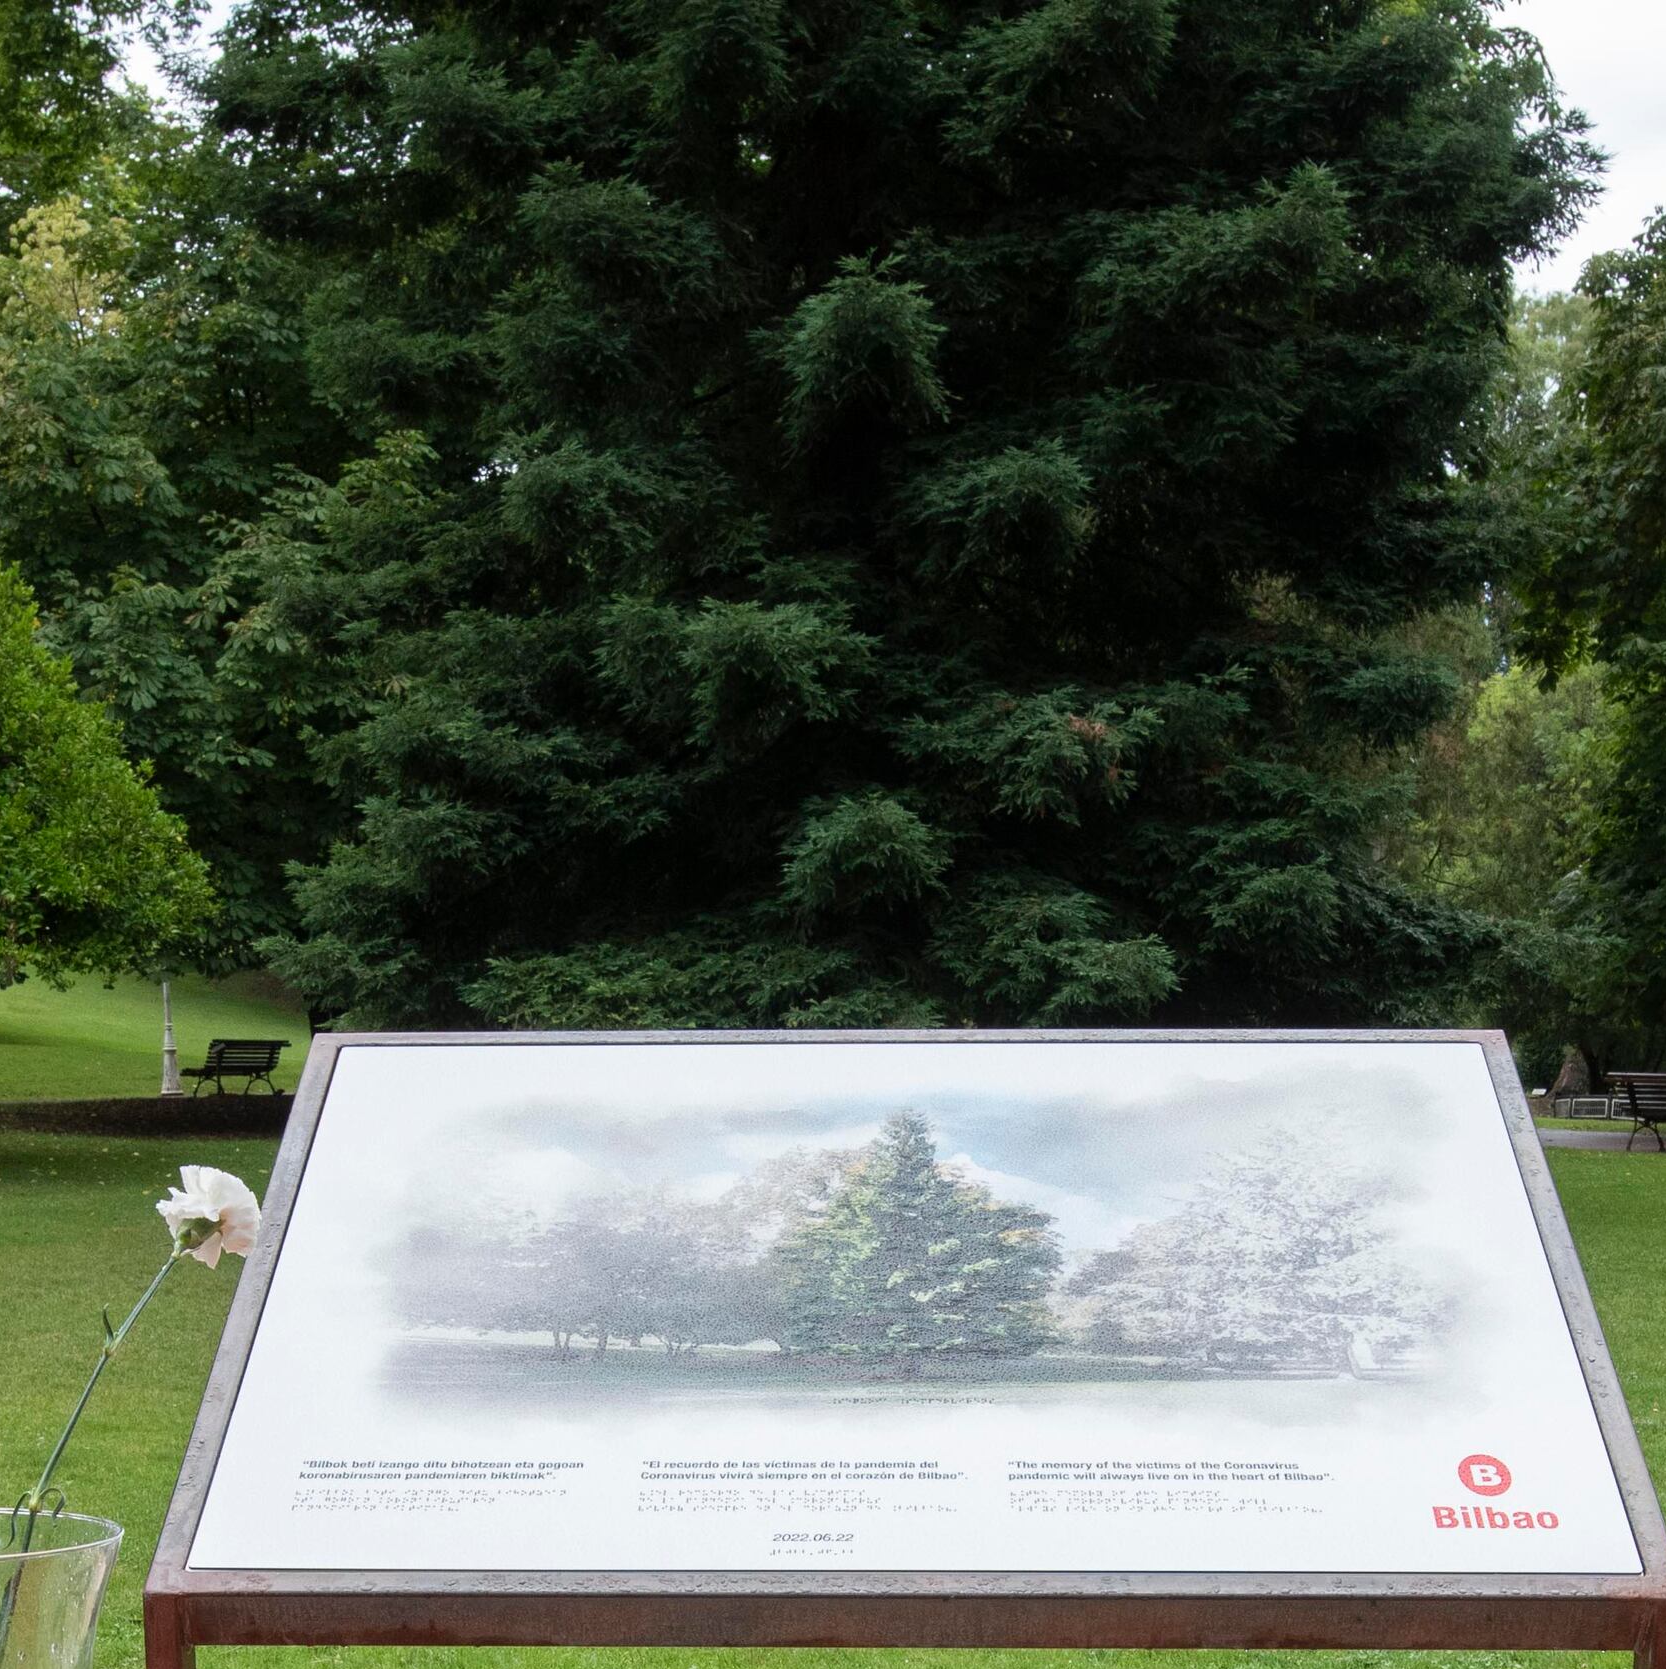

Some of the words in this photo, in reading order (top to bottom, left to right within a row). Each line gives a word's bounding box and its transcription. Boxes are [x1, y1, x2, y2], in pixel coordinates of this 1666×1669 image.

[351, 1460, 377, 1470] beti
[378, 1461, 420, 1473] izango
[422, 1461, 448, 1470] ditu
[450, 1461, 512, 1470] bihotzean
[514, 1461, 535, 1470] eta
[537, 1462, 585, 1473] gogoan
[663, 1460, 720, 1470] recuerdo
[722, 1460, 739, 1470] de
[741, 1460, 761, 1470] las
[763, 1460, 817, 1470] víctimas
[819, 1460, 836, 1470] de
[839, 1460, 851, 1470] la
[854, 1460, 916, 1471] pandemia
[919, 1460, 939, 1470] del
[1040, 1463, 1093, 1472] memory
[1095, 1461, 1109, 1470] of
[1111, 1461, 1133, 1470] the
[1135, 1461, 1182, 1470] victims
[1184, 1461, 1197, 1470] of
[1199, 1461, 1221, 1470] the
[1223, 1461, 1300, 1470] Coronavirus
[298, 1471, 402, 1481] koronabirusaren
[404, 1471, 487, 1481] pandemiaren
[640, 1472, 716, 1481] Coronavirus
[719, 1471, 754, 1481] vivirá
[756, 1472, 809, 1482] siempre
[810, 1473, 827, 1481] en
[830, 1471, 842, 1481] el
[844, 1471, 896, 1481] corazón
[898, 1471, 915, 1481] de
[1008, 1472, 1070, 1483] pandemic
[1072, 1472, 1096, 1481] will
[1099, 1472, 1145, 1483] always
[1147, 1472, 1170, 1481] live
[1192, 1472, 1205, 1481] in
[1207, 1472, 1229, 1481] the
[1231, 1472, 1265, 1481] heart
[1267, 1472, 1280, 1481] of
[1469, 1464, 1503, 1486] B
[1432, 1506, 1559, 1529] Bilbao
[773, 1533, 854, 1542] 2022.06.22
